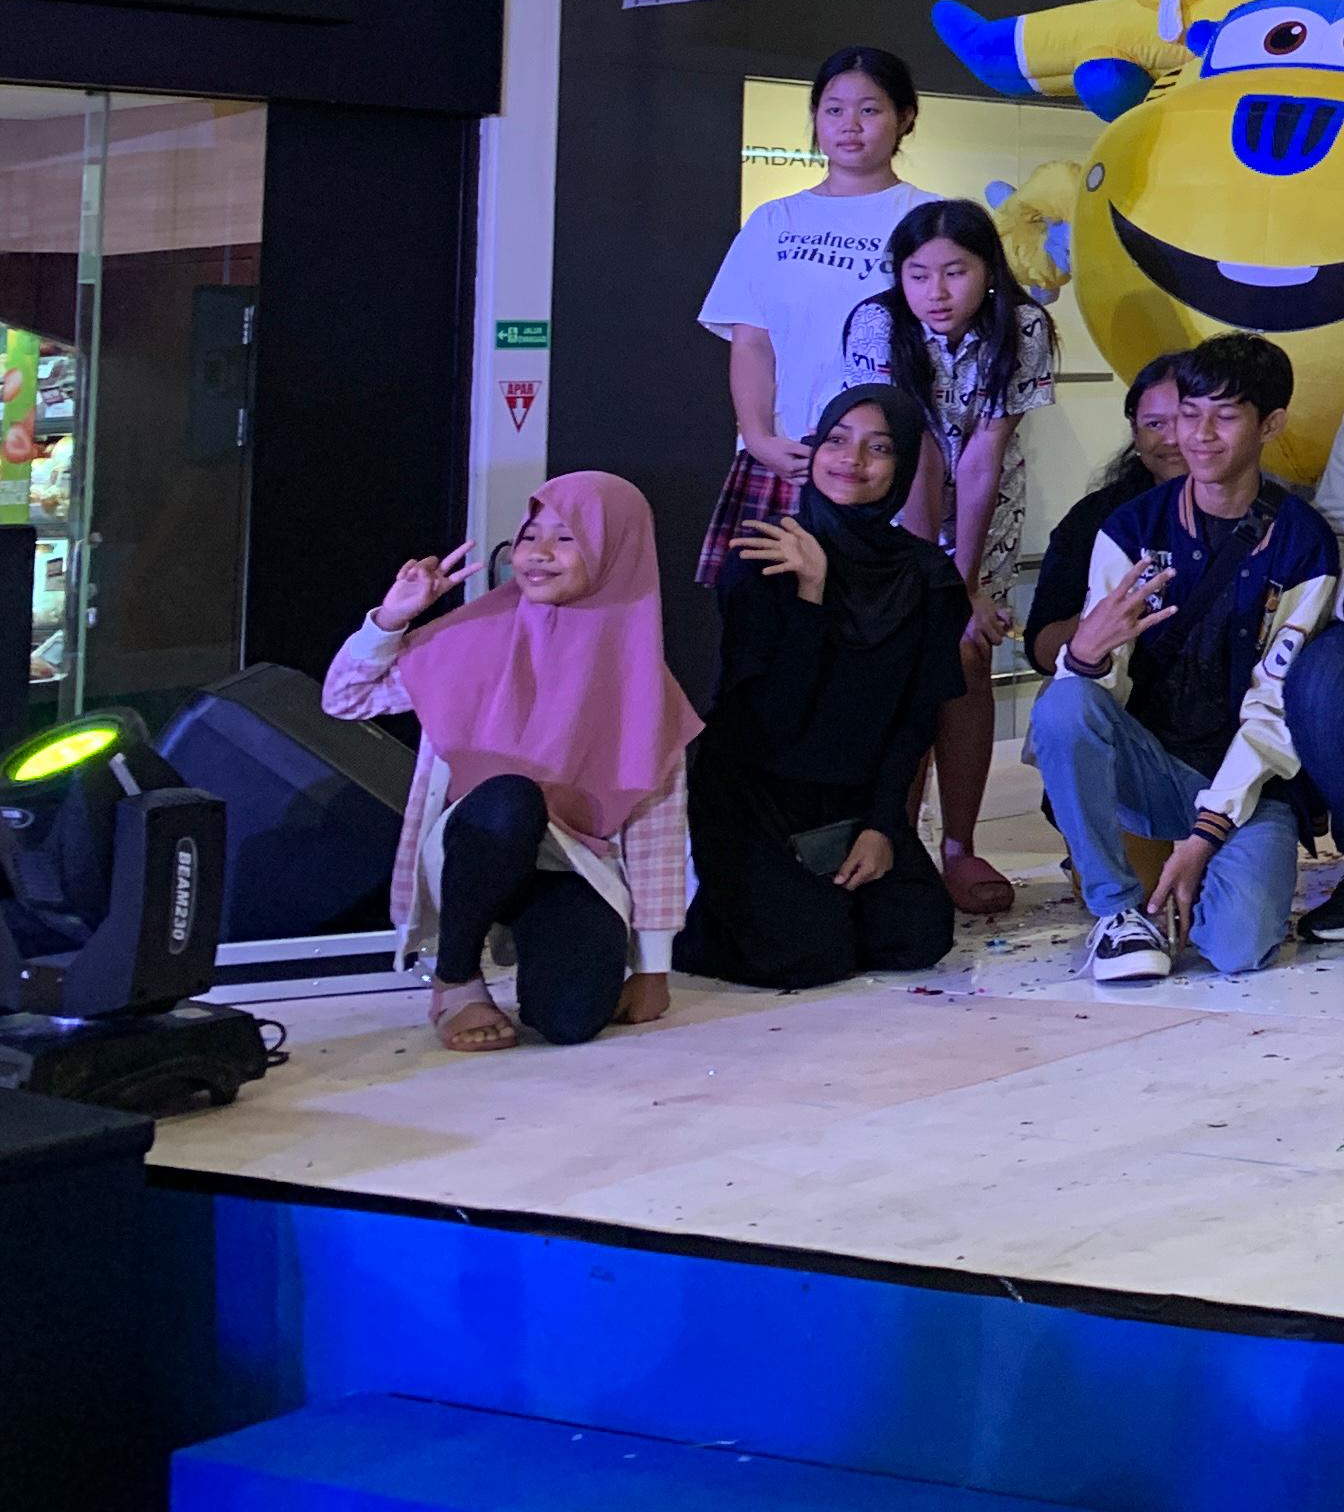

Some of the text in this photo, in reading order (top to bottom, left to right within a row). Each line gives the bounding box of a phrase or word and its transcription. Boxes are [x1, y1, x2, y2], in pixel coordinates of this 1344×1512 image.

[778, 231, 882, 252] Greatness
[777, 247, 855, 270] within
[507, 383, 534, 395] APAR
[172, 851, 192, 941] BEAM230
